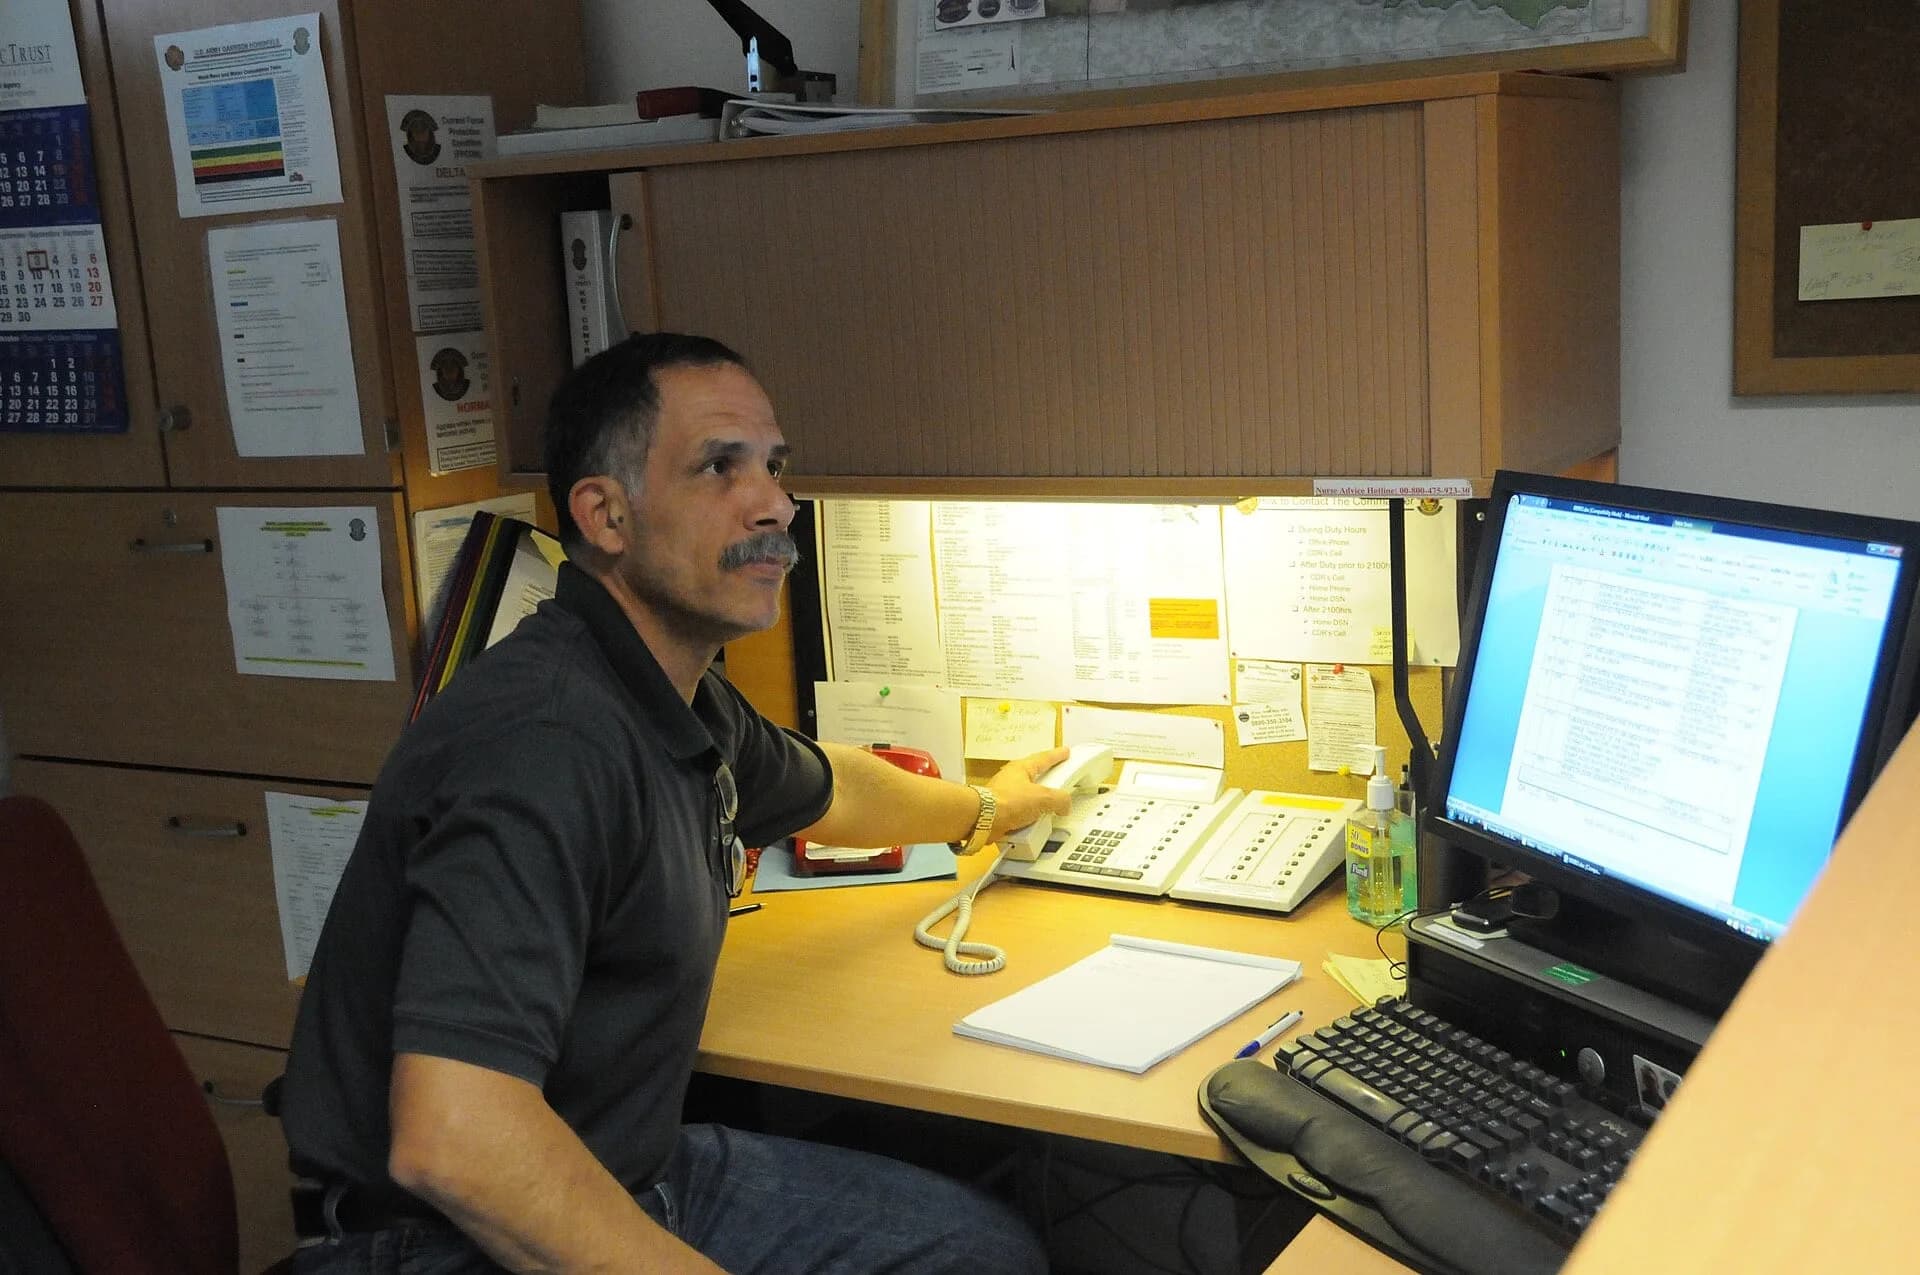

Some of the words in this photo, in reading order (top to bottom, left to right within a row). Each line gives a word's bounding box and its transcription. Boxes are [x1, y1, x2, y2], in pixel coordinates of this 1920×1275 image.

[0, 152, 8, 164] 5
[19, 151, 26, 163] 6
[37, 149, 44, 161] 7
[16, 166, 28, 177] 13
[34, 165, 46, 176] 14
[0, 181, 12, 192] 19
[17, 180, 30, 192] 20
[35, 179, 48, 191] 21
[1, 195, 14, 207] 26
[19, 194, 31, 206] 27
[37, 194, 50, 205] 28
[52, 255, 59, 265] 4
[90, 253, 97, 264] 6
[18, 270, 25, 281] 9
[32, 270, 42, 280] 10
[49, 269, 60, 279] 11
[68, 268, 80, 279] 12
[87, 267, 100, 278] 13
[15, 283, 27, 294] 16
[33, 283, 44, 294] 17
[51, 283, 63, 293] 18
[70, 282, 82, 293] 19
[88, 281, 102, 292] 20
[15, 298, 28, 309] 23
[34, 297, 47, 308] 24
[53, 297, 65, 308] 25
[72, 296, 84, 307] 26
[90, 295, 103, 306] 27
[0, 312, 12, 323] 29
[18, 311, 31, 322] 30
[51, 358, 56, 369] 1
[67, 357, 75, 369] 2
[14, 371, 21, 383] 6
[32, 371, 39, 382] 7
[51, 371, 58, 383] 8
[69, 371, 76, 382] 9
[9, 385, 21, 396] 13
[27, 385, 40, 396] 14
[46, 385, 59, 396] 15
[65, 385, 78, 396] 16
[8, 399, 21, 410] 20
[27, 399, 39, 410] 21
[46, 399, 59, 410] 22
[65, 399, 78, 410] 23
[8, 412, 21, 424] 27
[27, 412, 40, 424] 28
[46, 412, 59, 424] 29
[65, 412, 78, 424] 30
[1316, 487, 1338, 495] Nurse
[1341, 487, 1366, 495] Advice
[1292, 496, 1328, 505] Contact
[1333, 496, 1351, 505] The
[1298, 525, 1323, 535] During
[1324, 525, 1342, 535] Duty
[1344, 526, 1368, 534] Hours
[1300, 560, 1318, 569] After
[1320, 560, 1336, 570] Duty
[1338, 561, 1355, 570] prior
[1357, 561, 1365, 569] to
[1303, 605, 1320, 613] After
[1322, 606, 1352, 614] 2100hrs
